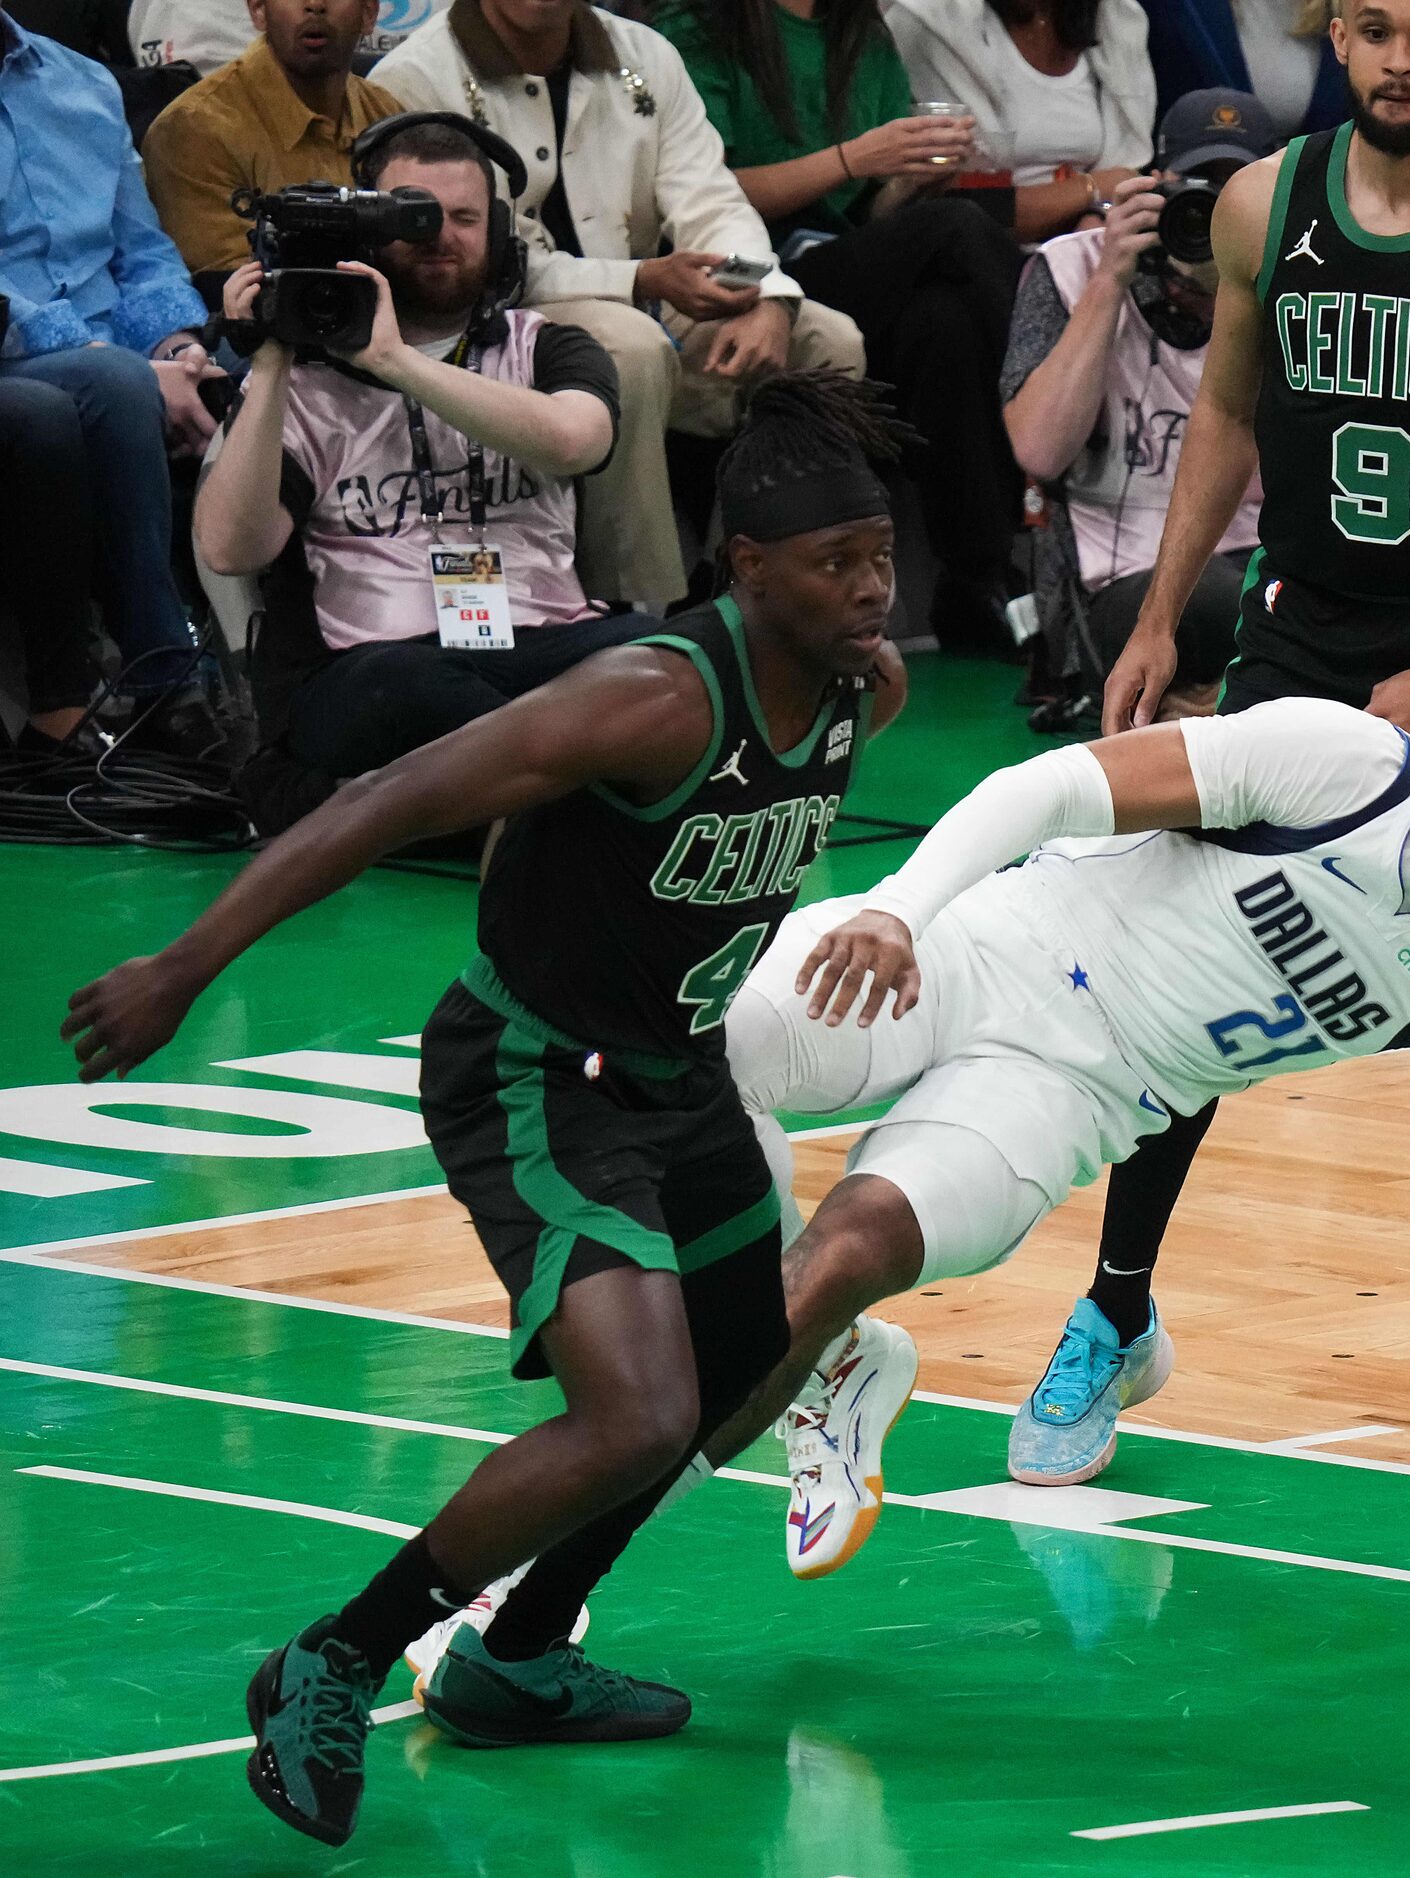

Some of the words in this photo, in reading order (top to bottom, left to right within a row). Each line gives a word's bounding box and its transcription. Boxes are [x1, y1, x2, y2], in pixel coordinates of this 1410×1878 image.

[677, 921, 770, 1036] 4
[1233, 866, 1393, 1042] DALLAS
[1203, 994, 1329, 1071] 21
